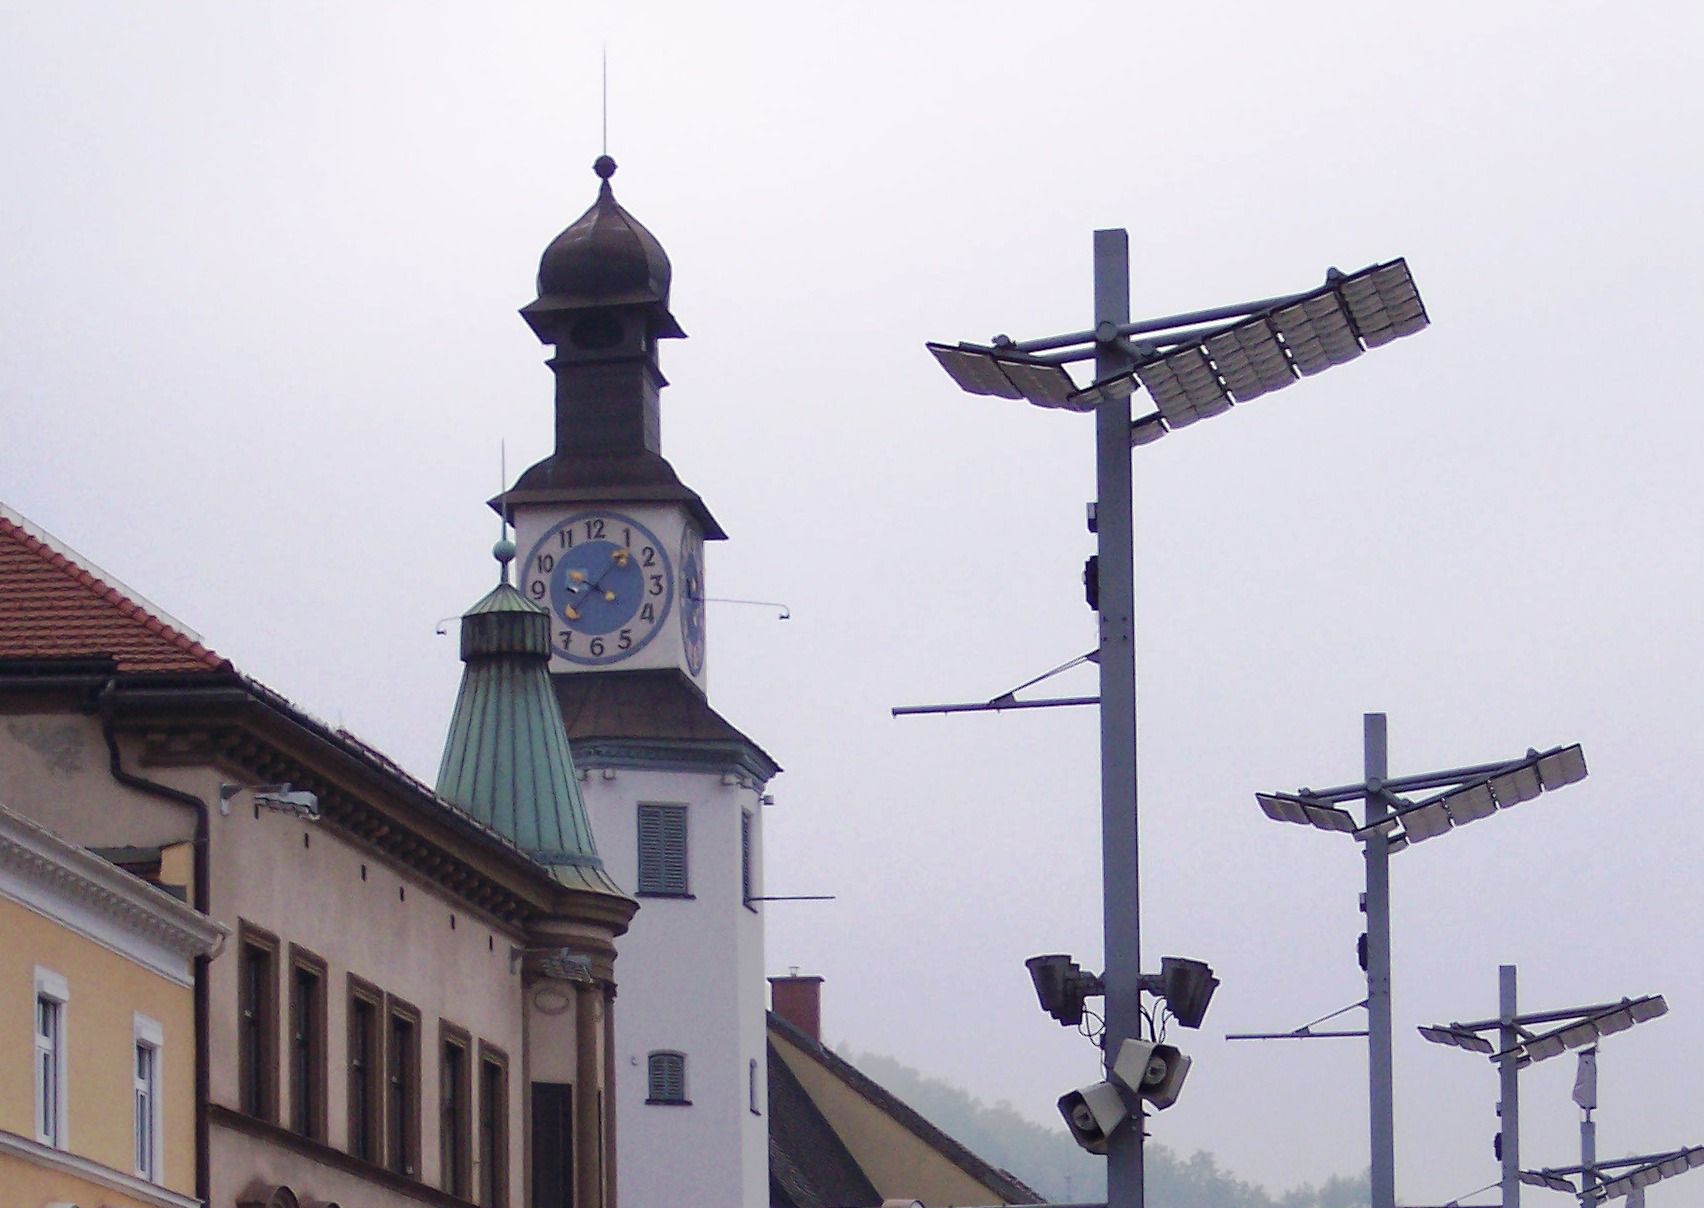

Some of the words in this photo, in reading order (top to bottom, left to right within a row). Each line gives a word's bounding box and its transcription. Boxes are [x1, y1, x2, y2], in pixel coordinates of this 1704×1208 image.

[559, 529, 573, 549] 11
[585, 519, 606, 540] 12
[622, 527, 631, 548] 1
[537, 554, 555, 574] 10
[642, 546, 656, 567] 2
[531, 580, 546, 600] 9
[649, 574, 664, 596] 3
[640, 602, 655, 625] 4
[559, 630, 573, 651] 7
[590, 637, 604, 657] 6
[617, 629, 632, 650] 5
